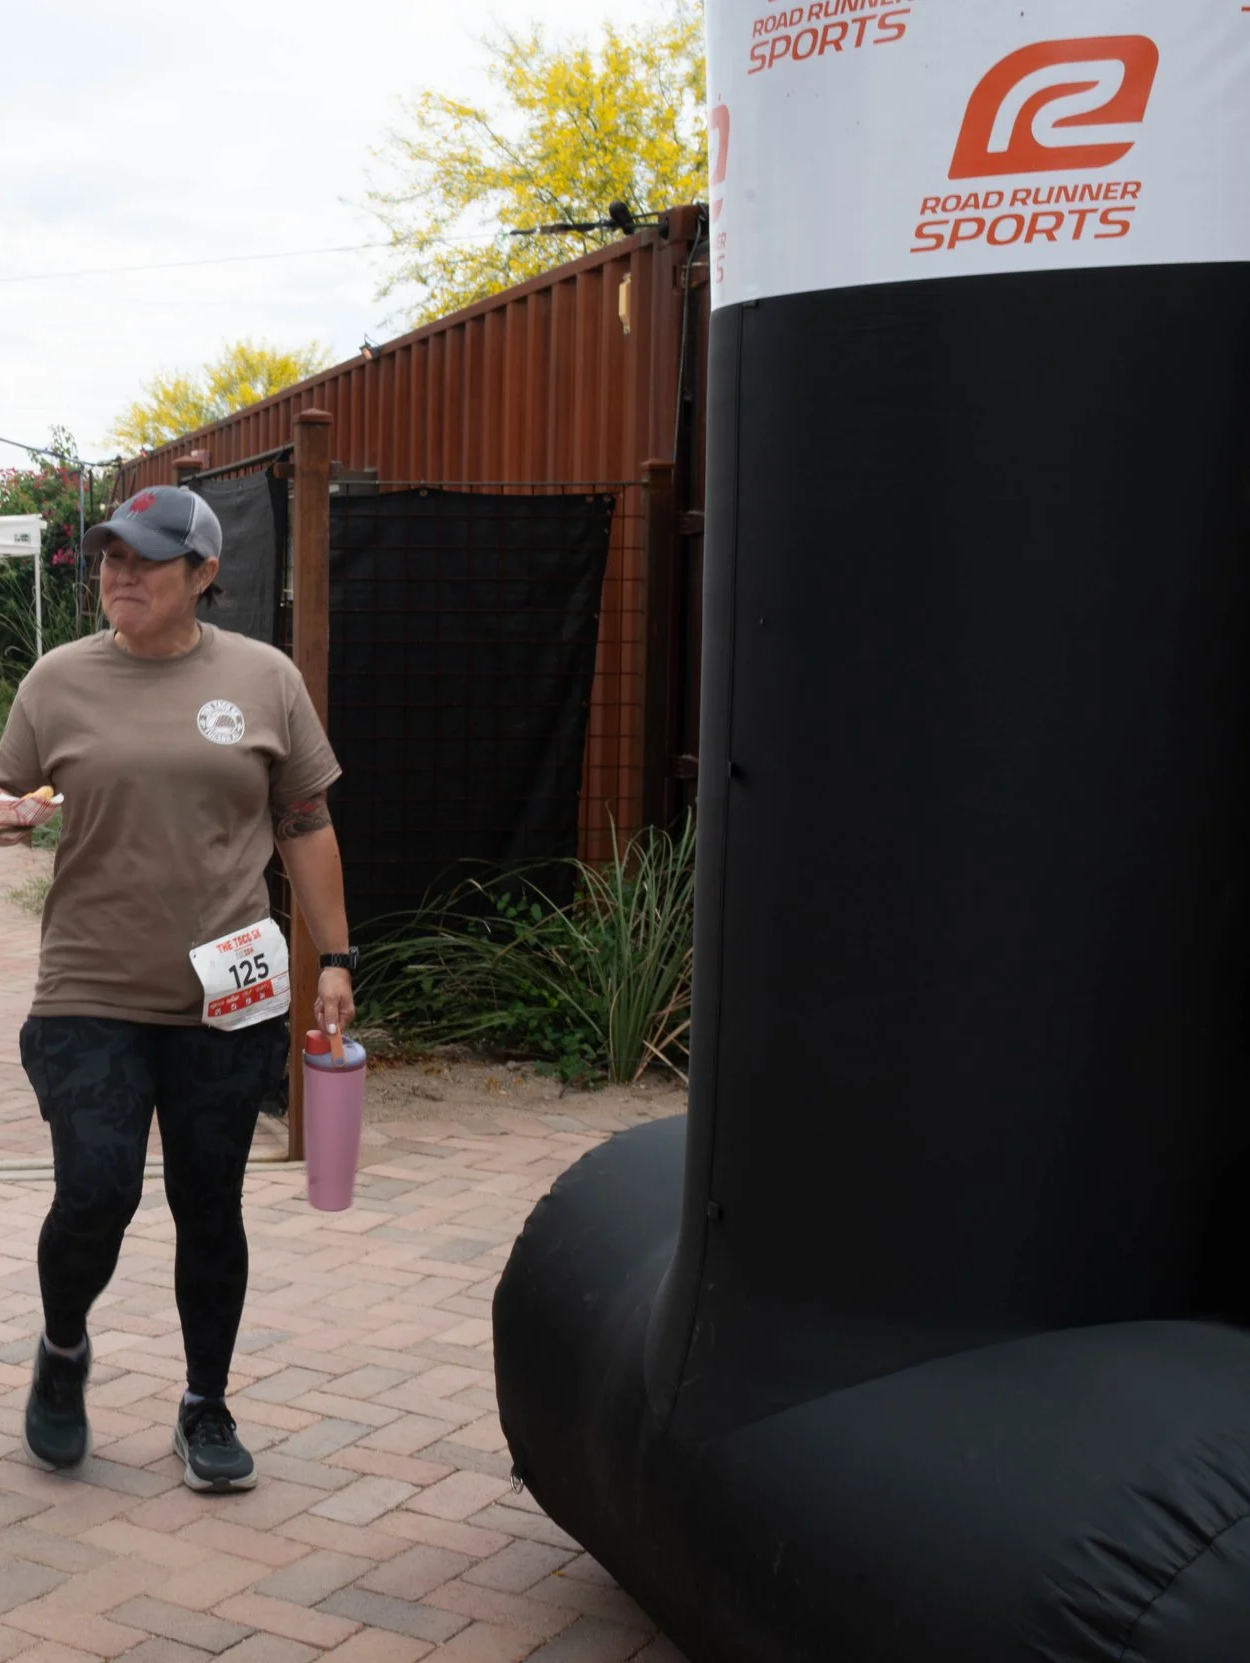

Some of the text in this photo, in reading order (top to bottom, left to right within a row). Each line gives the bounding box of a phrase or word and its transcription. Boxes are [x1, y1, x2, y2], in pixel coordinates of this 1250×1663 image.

[752, 0, 912, 38] ROAD RUNN
[748, 8, 911, 75] SPORTS
[920, 180, 1142, 216] ROAD RUNNER
[910, 206, 1135, 253] SPORTS
[216, 940, 234, 953] THE
[229, 953, 269, 989] 125
